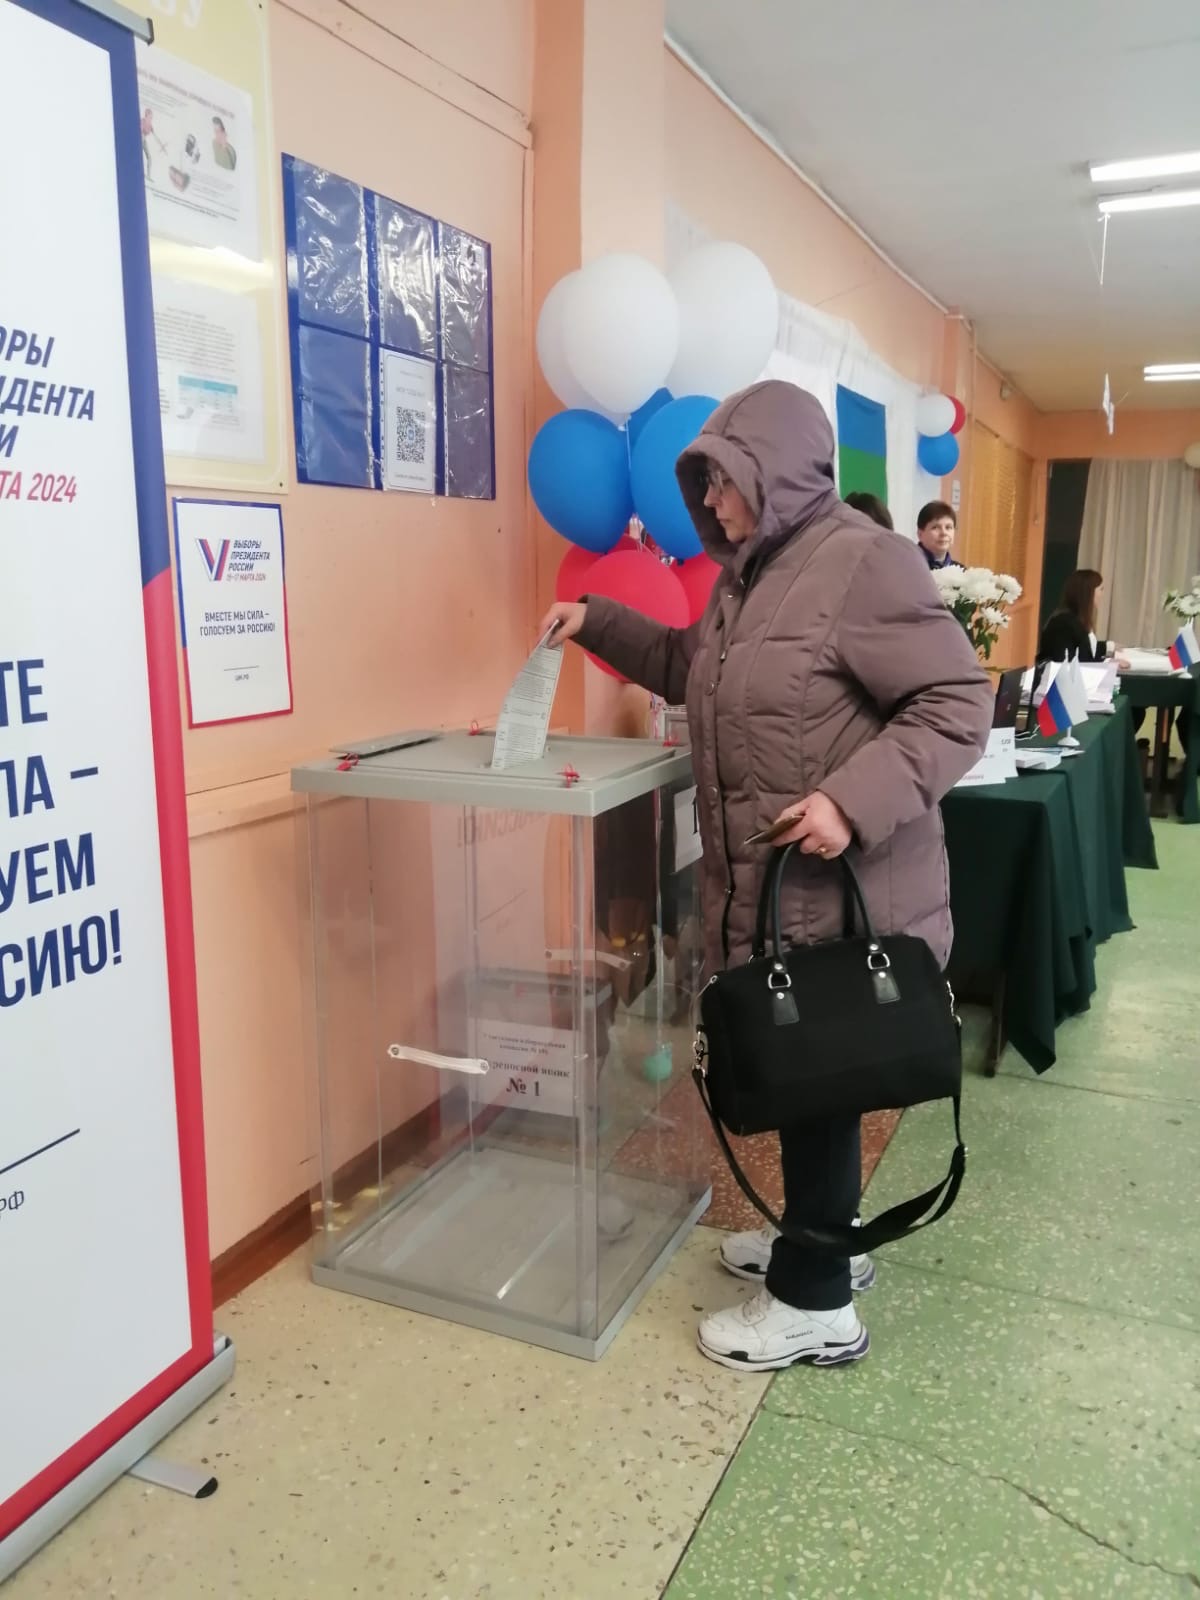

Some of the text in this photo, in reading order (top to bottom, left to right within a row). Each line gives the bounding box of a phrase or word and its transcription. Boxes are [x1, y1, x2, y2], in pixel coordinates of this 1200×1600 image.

[0, 326, 55, 368] РЫ
[0, 375, 95, 421] ДЕНТА
[27, 472, 77, 503] 2024
[233, 539, 262, 549] ВЫБОРЫ
[230, 551, 270, 560] ПРЕЗИДЕНТА
[228, 562, 254, 571] РОССИИ
[204, 611, 232, 622] ВМЕСТЕ
[233, 610, 246, 621] МЫ
[246, 610, 264, 620] СИЛА
[199, 622, 276, 636] ГОЛОСУЕМ ЗА РОССИЮ!
[506, 1077, 540, 1096] № 1
